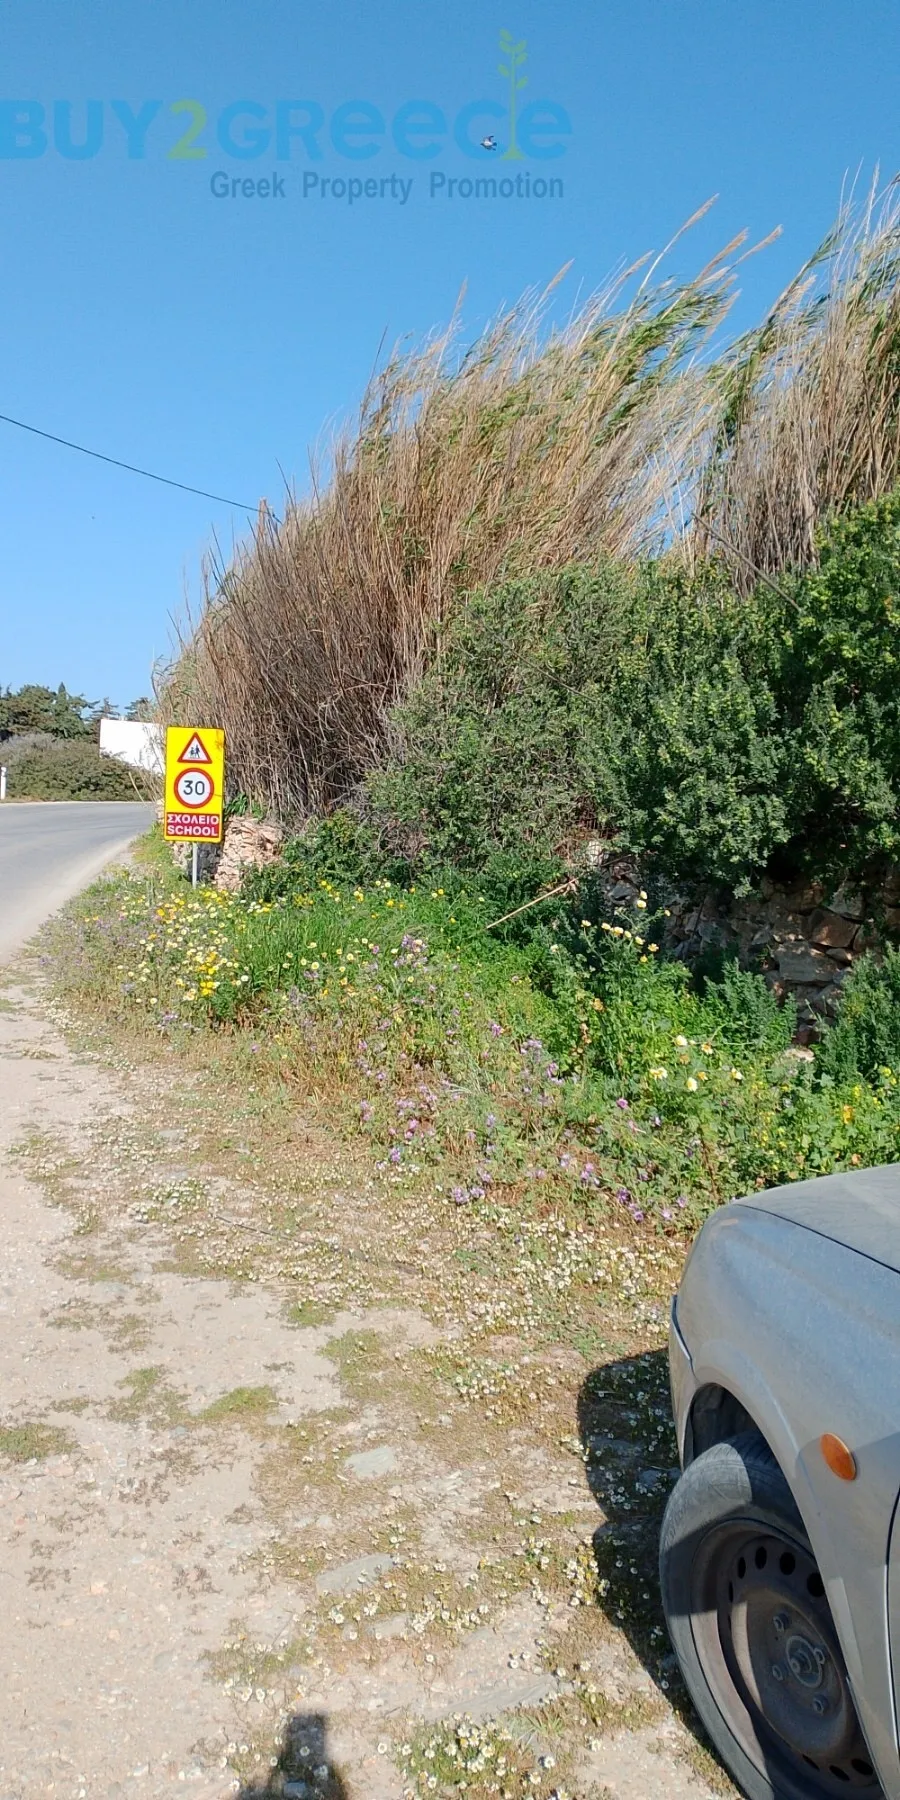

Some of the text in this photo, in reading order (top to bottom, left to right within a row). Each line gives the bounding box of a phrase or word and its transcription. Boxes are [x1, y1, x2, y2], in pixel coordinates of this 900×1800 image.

[183, 780, 205, 796] 30
[167, 814, 219, 825] ΣΧΟΛΕΙΟ
[167, 825, 218, 836] SCHOOL
